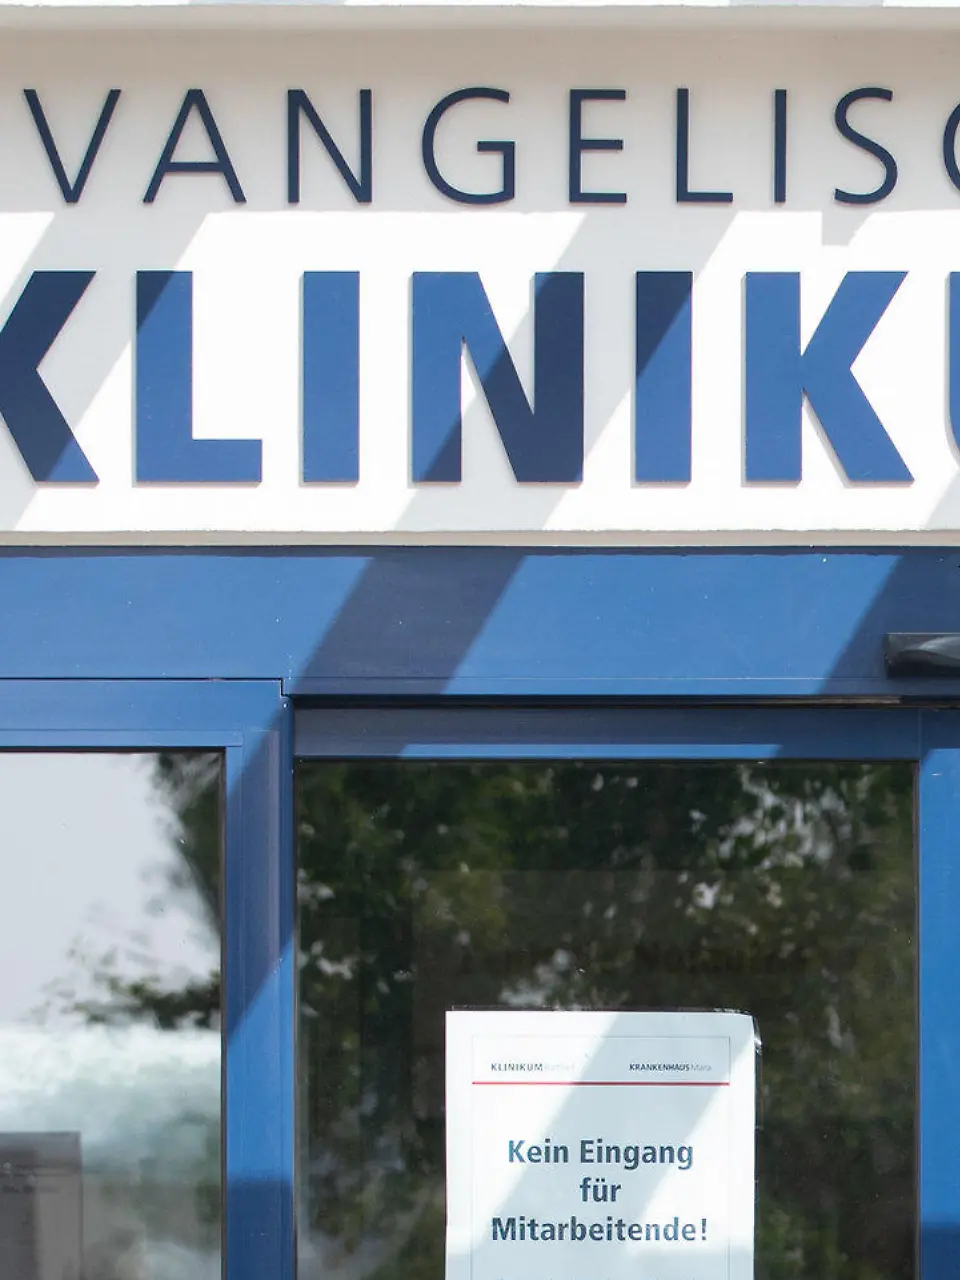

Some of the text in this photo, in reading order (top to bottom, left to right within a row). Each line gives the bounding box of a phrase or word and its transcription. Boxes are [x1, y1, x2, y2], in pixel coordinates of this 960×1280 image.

[508, 1138, 694, 1170] Kein Eingang
[579, 1176, 622, 1203] für
[491, 1215, 708, 1242] Mitarbeitende!
